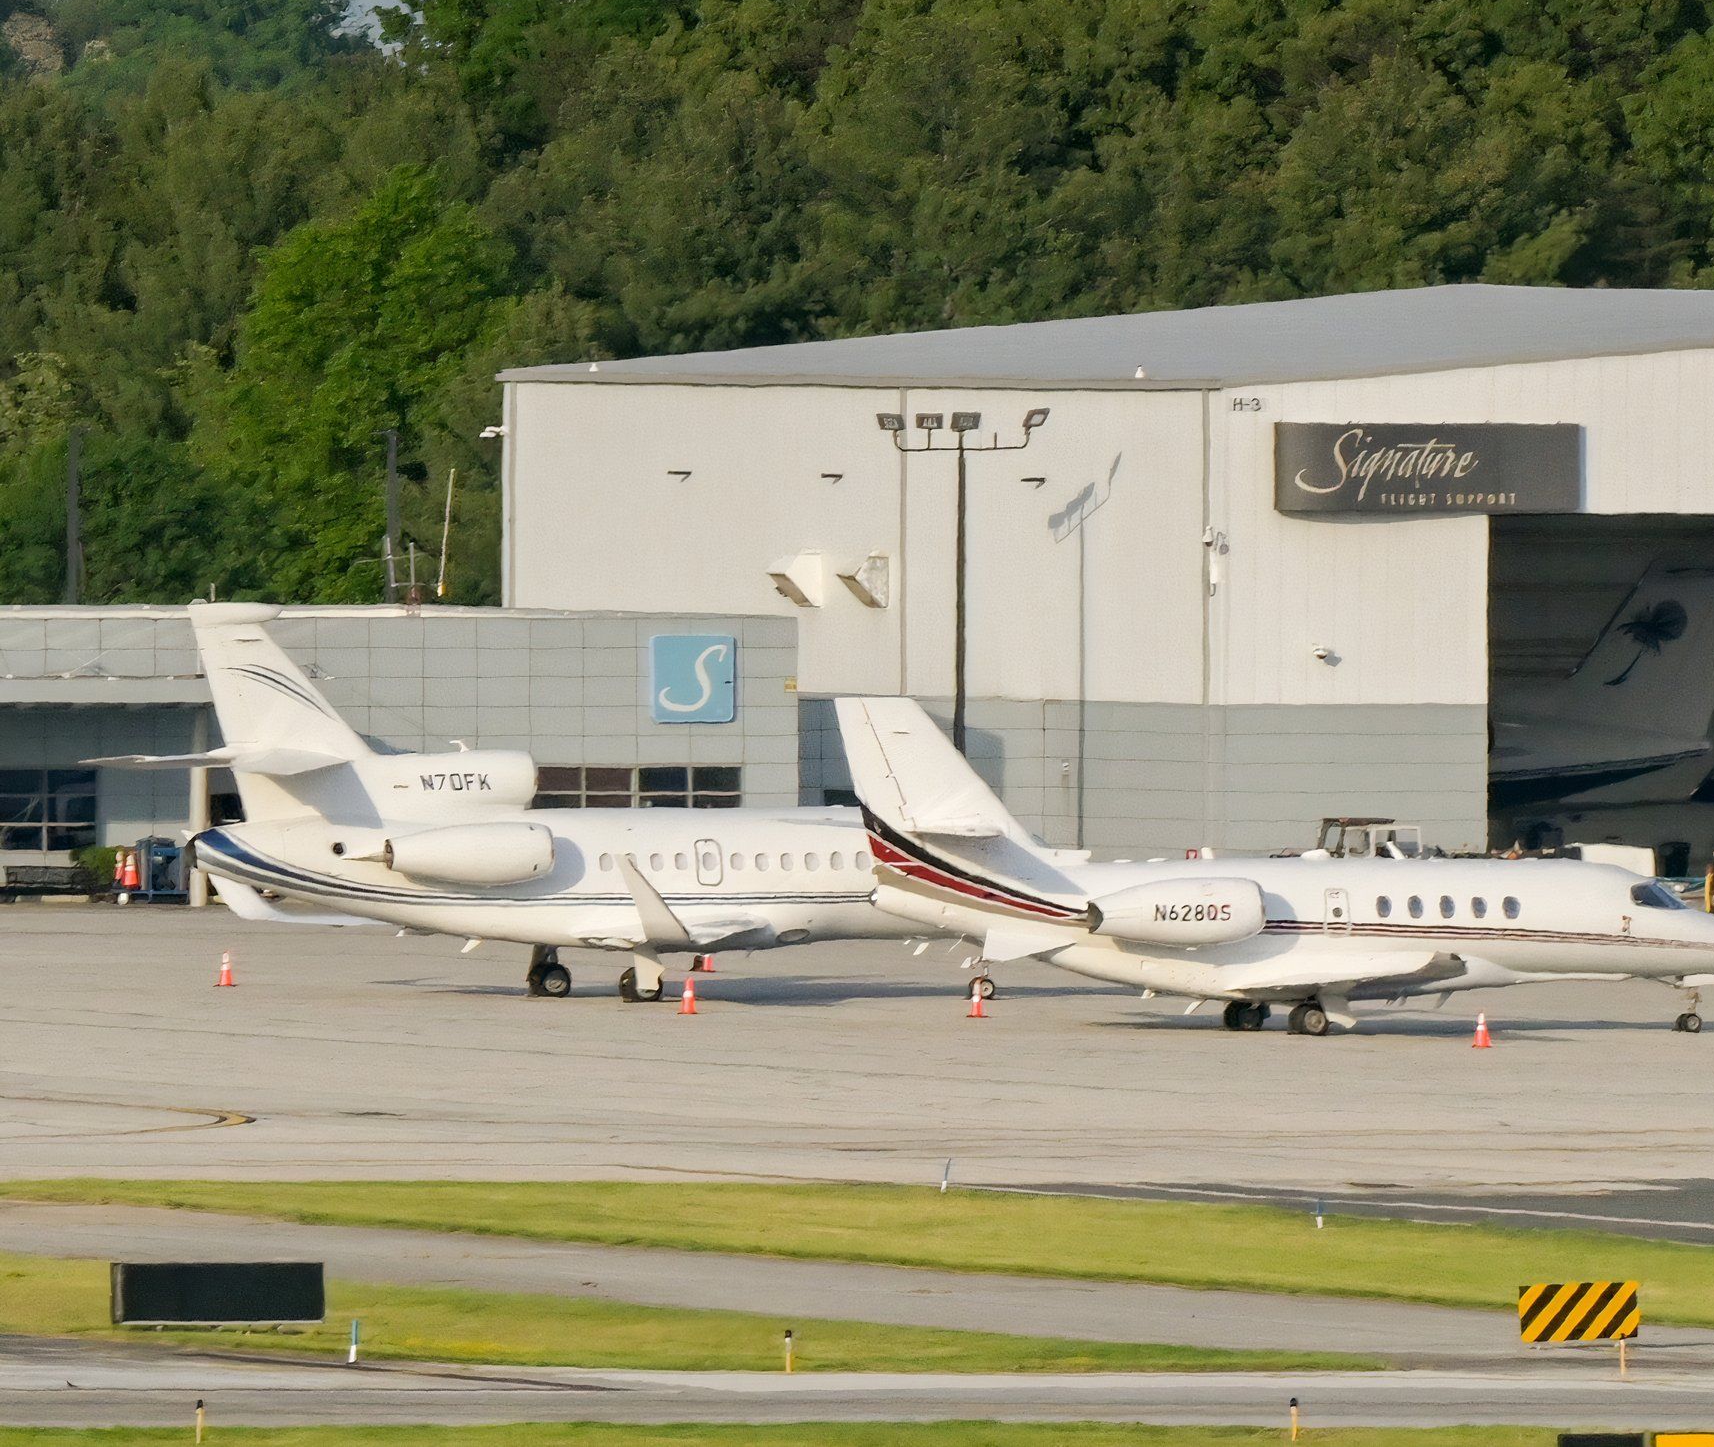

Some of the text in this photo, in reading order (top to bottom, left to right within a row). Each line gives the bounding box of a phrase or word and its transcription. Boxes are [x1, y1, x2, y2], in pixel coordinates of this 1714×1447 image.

[1232, 398, 1263, 412] H-3
[1295, 428, 1480, 502] Signature
[1380, 492, 1517, 506] FLIGHT SUPPORT
[419, 773, 492, 791] N70FK
